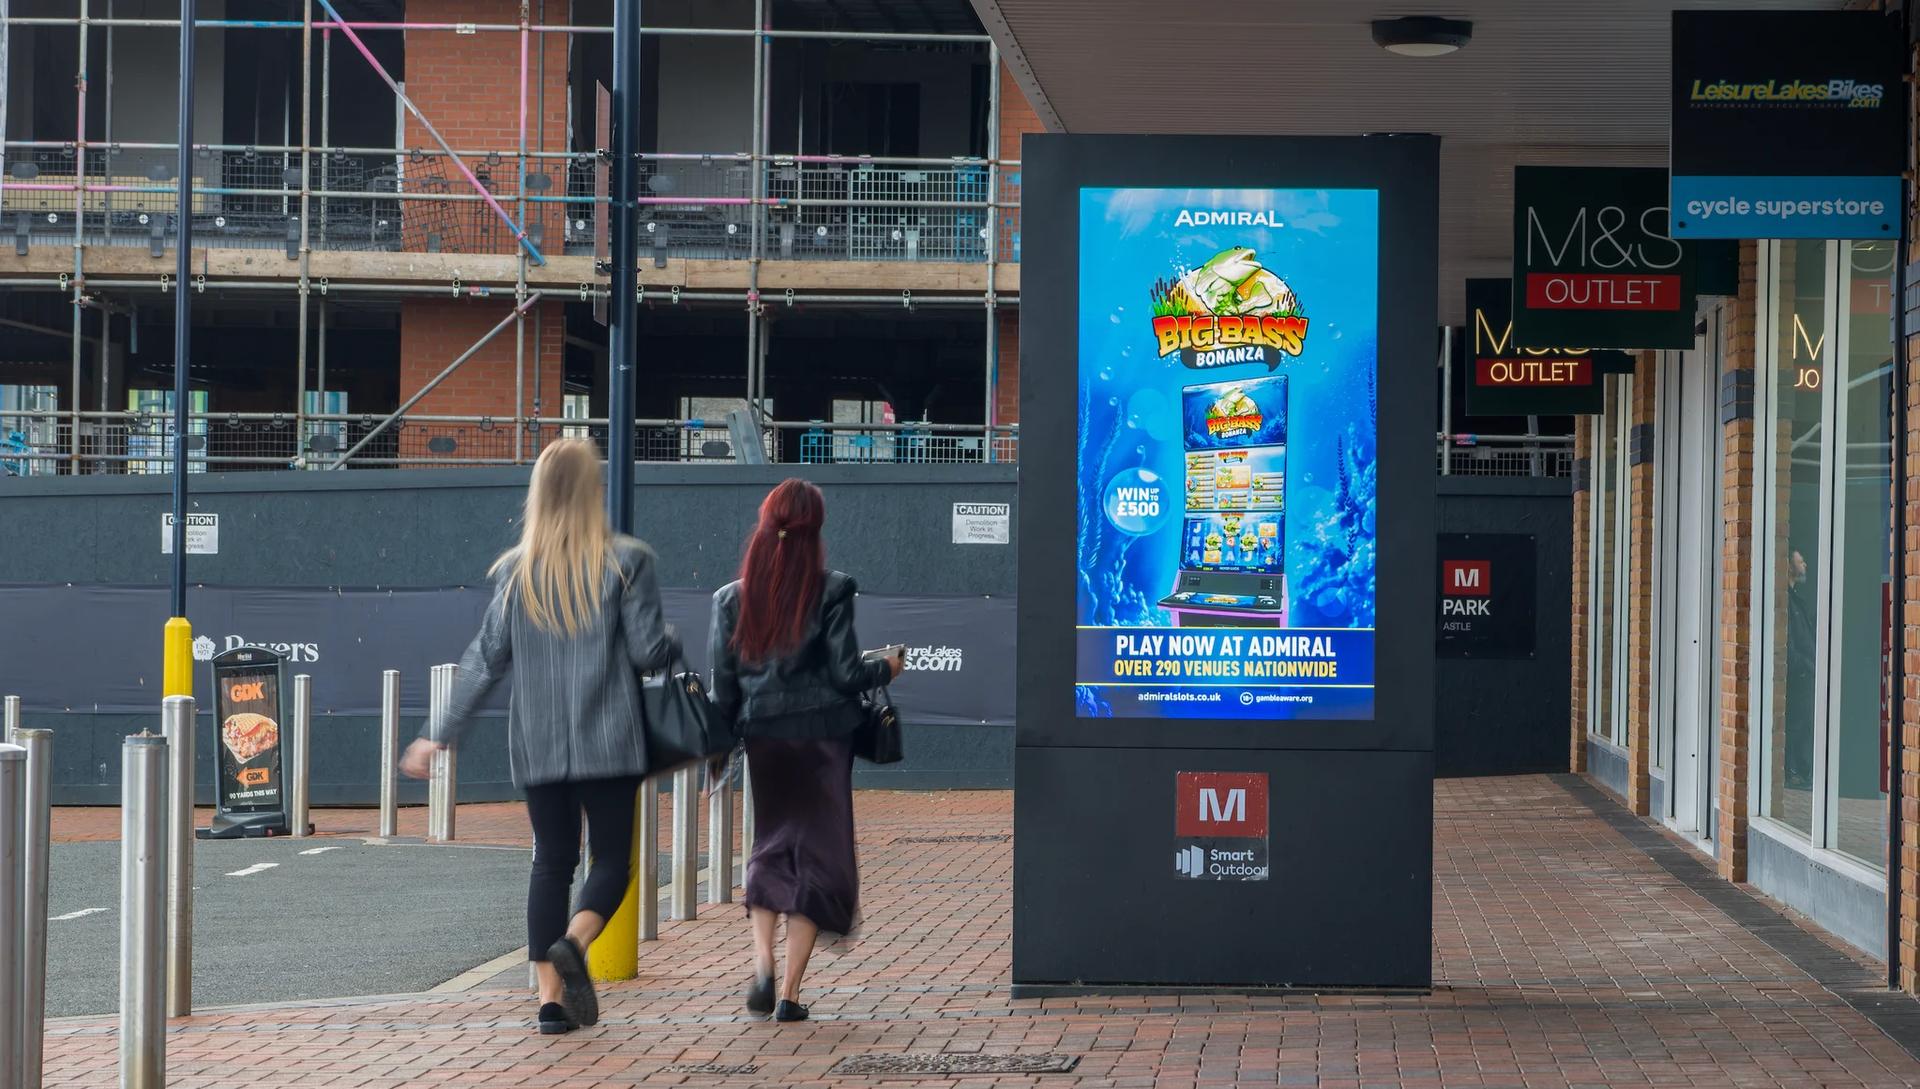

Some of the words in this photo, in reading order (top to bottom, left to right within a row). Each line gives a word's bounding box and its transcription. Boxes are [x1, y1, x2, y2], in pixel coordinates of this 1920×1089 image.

[1691, 80, 1884, 101] LeisureLakesBikes
[1687, 196, 1750, 219] cycle
[1754, 197, 1884, 219] superstore
[1174, 210, 1284, 228] ADMIRAL
[1527, 205, 1683, 269] M&S
[1545, 278, 1662, 304] OUTLET
[1152, 315, 1214, 358] BIG
[1218, 315, 1310, 357] BASS
[1195, 346, 1264, 367] BONANZA
[1490, 362, 1579, 382] OUTLET
[1116, 487, 1150, 501] WIN
[1150, 487, 1160, 495] UP
[959, 505, 1005, 515] CAUTION
[1116, 501, 1160, 517] £500
[168, 516, 214, 525] CTION
[1454, 568, 1480, 587] M
[1443, 599, 1490, 615] PARK
[1443, 622, 1471, 631] ASTLE
[1116, 635, 1164, 656] PLAY
[1168, 635, 1216, 657] NOW
[1219, 636, 1244, 656] AT
[1248, 636, 1337, 657] ADMIRAL
[903, 656, 963, 671] s.com
[1114, 659, 1152, 676] OVER
[1155, 660, 1181, 676] 290
[1184, 660, 1240, 677] VENUES
[1243, 661, 1338, 678] NATIONWIDE
[230, 681, 265, 703] GDK
[1138, 691, 1221, 702] admiralslots.co.uk
[1256, 694, 1313, 703] gambleaware.org
[246, 771, 264, 782] GDK
[1199, 788, 1246, 822] M
[1210, 849, 1254, 861] Smart
[1210, 862, 1268, 876] Outdoor
